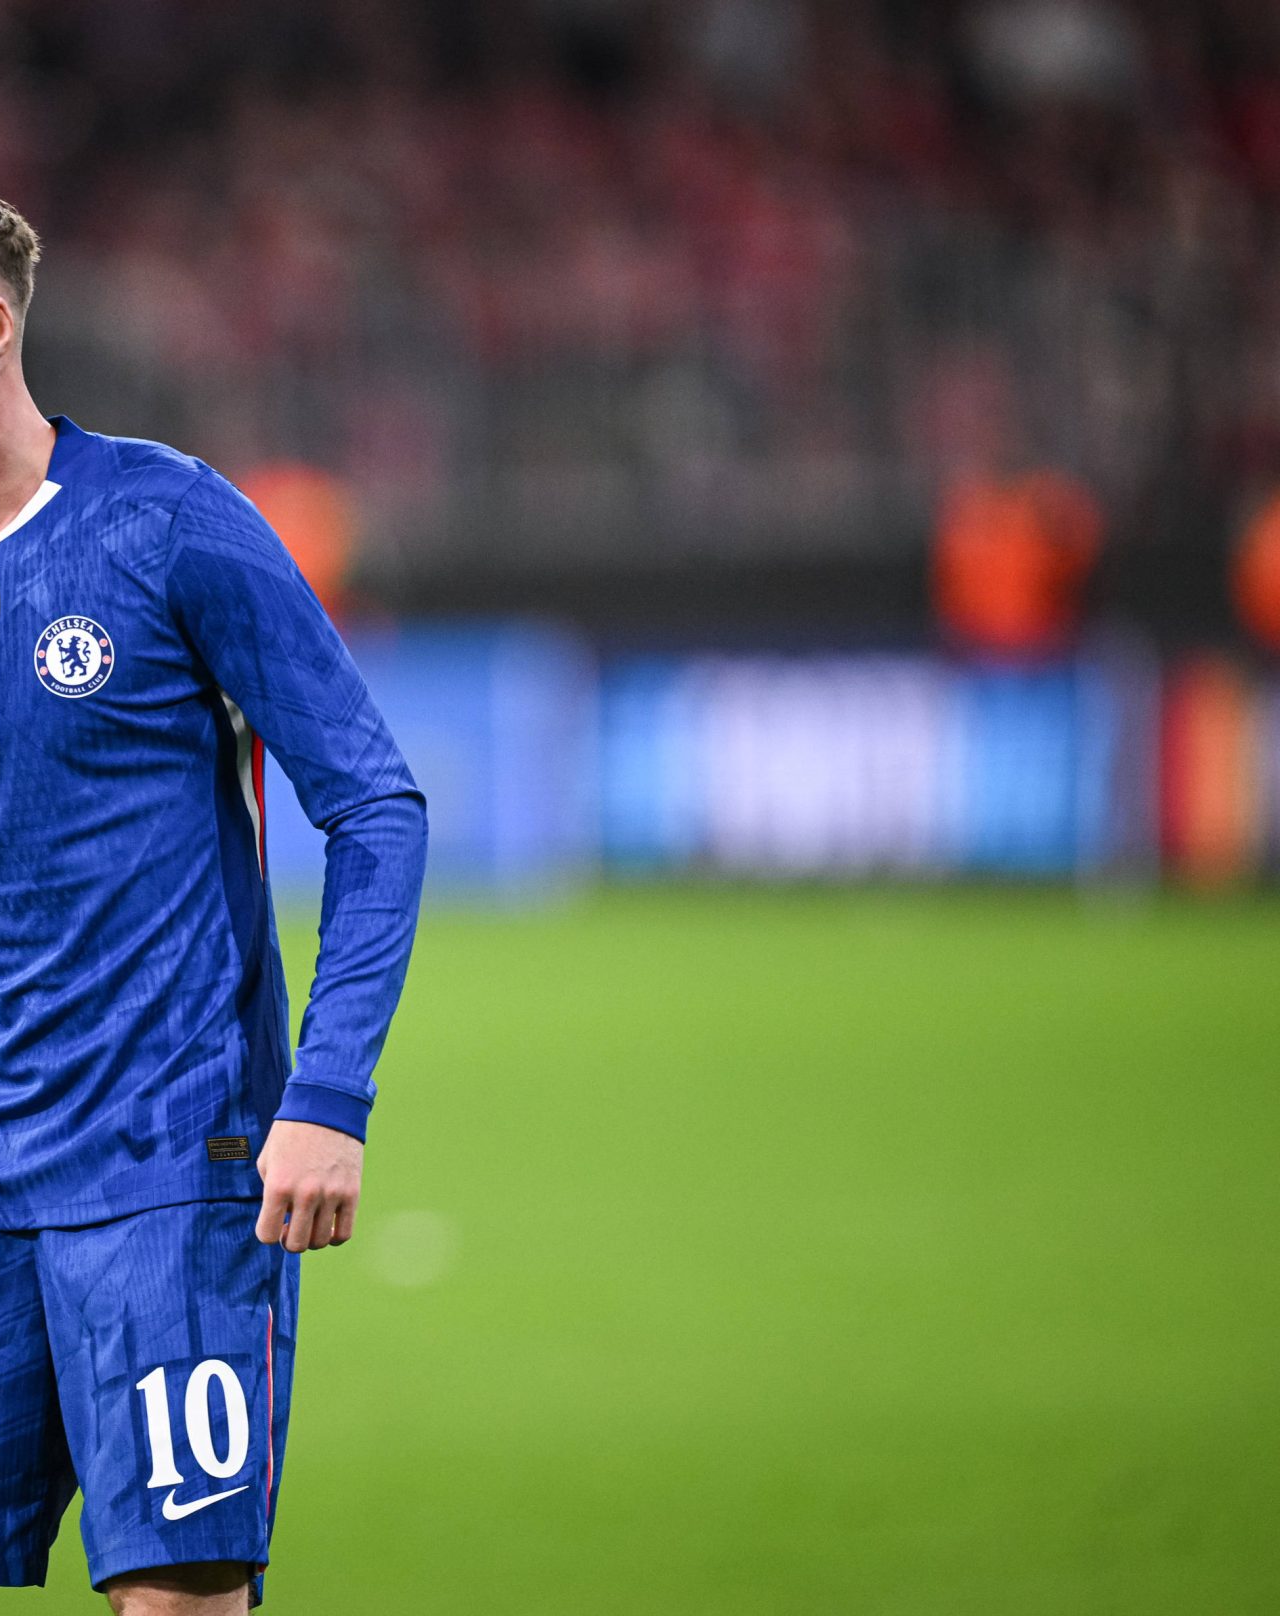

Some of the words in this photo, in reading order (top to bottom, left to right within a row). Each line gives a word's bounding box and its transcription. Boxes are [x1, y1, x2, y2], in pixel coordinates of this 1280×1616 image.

[45, 619, 94, 641] CHELSEA
[50, 681, 86, 694] FOOTBALL
[87, 673, 104, 689] CLUB
[136, 1359, 249, 1489] 10
